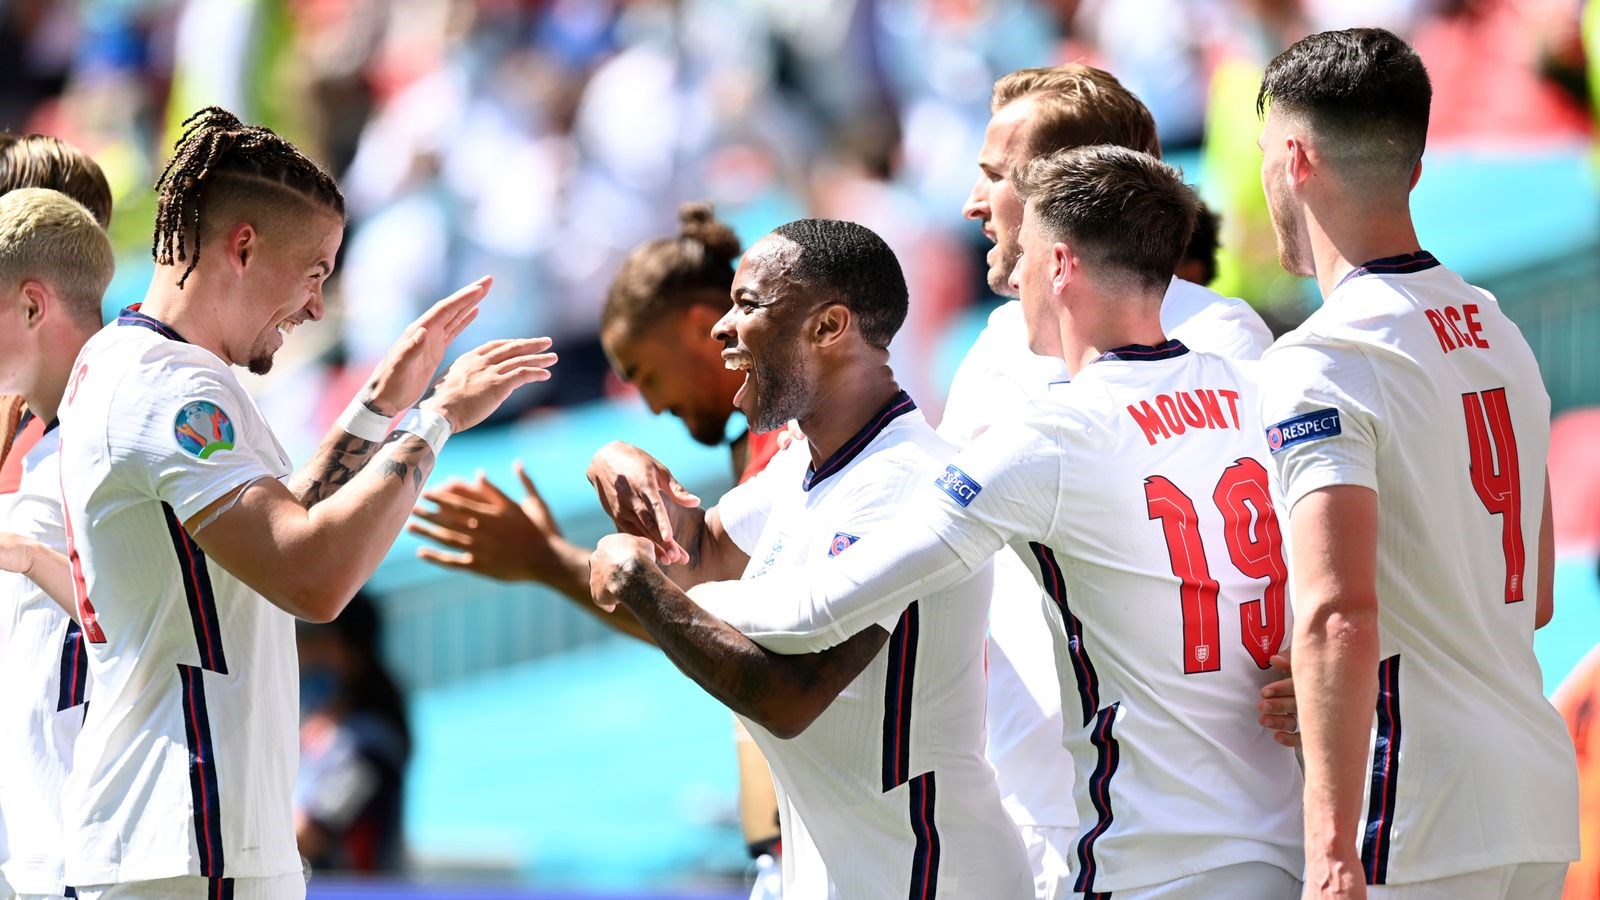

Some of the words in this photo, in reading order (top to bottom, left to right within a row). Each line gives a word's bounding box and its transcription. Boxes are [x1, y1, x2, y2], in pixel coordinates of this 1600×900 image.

[1424, 304, 1490, 354] RICE
[1126, 389, 1241, 446] MOUNT
[1282, 416, 1338, 441] RESPECT
[939, 470, 977, 500] ESPECT
[1461, 387, 1525, 604] 4
[1143, 457, 1288, 675] 19
